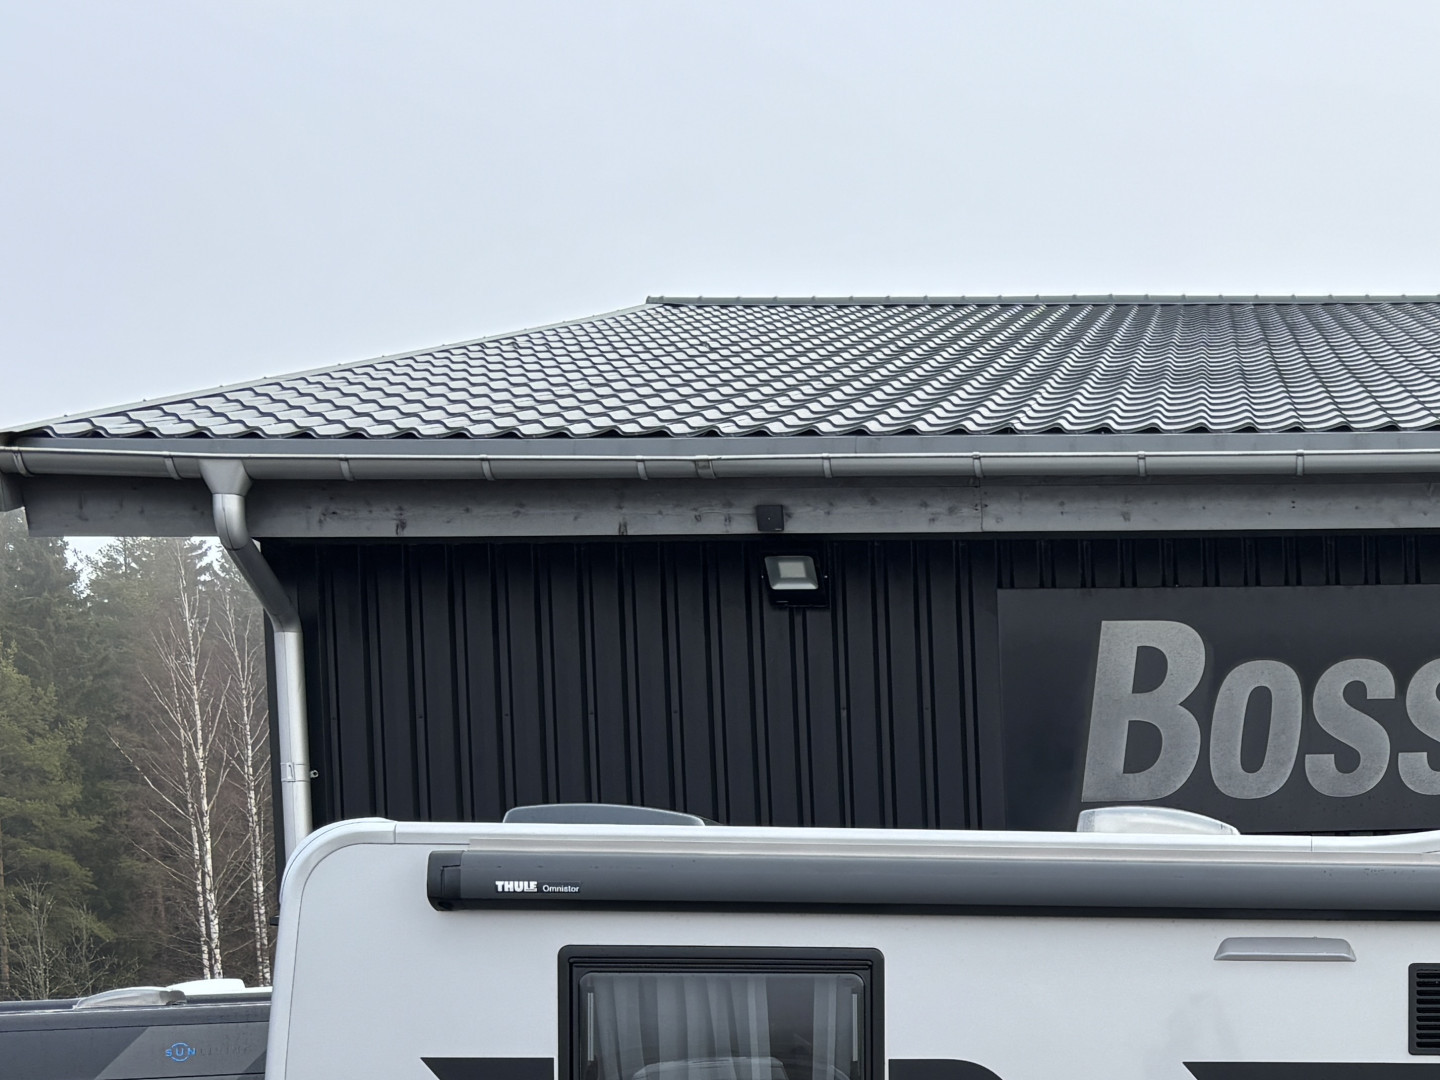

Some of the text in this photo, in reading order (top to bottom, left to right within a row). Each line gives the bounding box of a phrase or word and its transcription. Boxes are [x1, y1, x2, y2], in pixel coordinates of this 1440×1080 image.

[495, 880, 580, 893] THULE Omnistor
[165, 1047, 197, 1057] SUN
